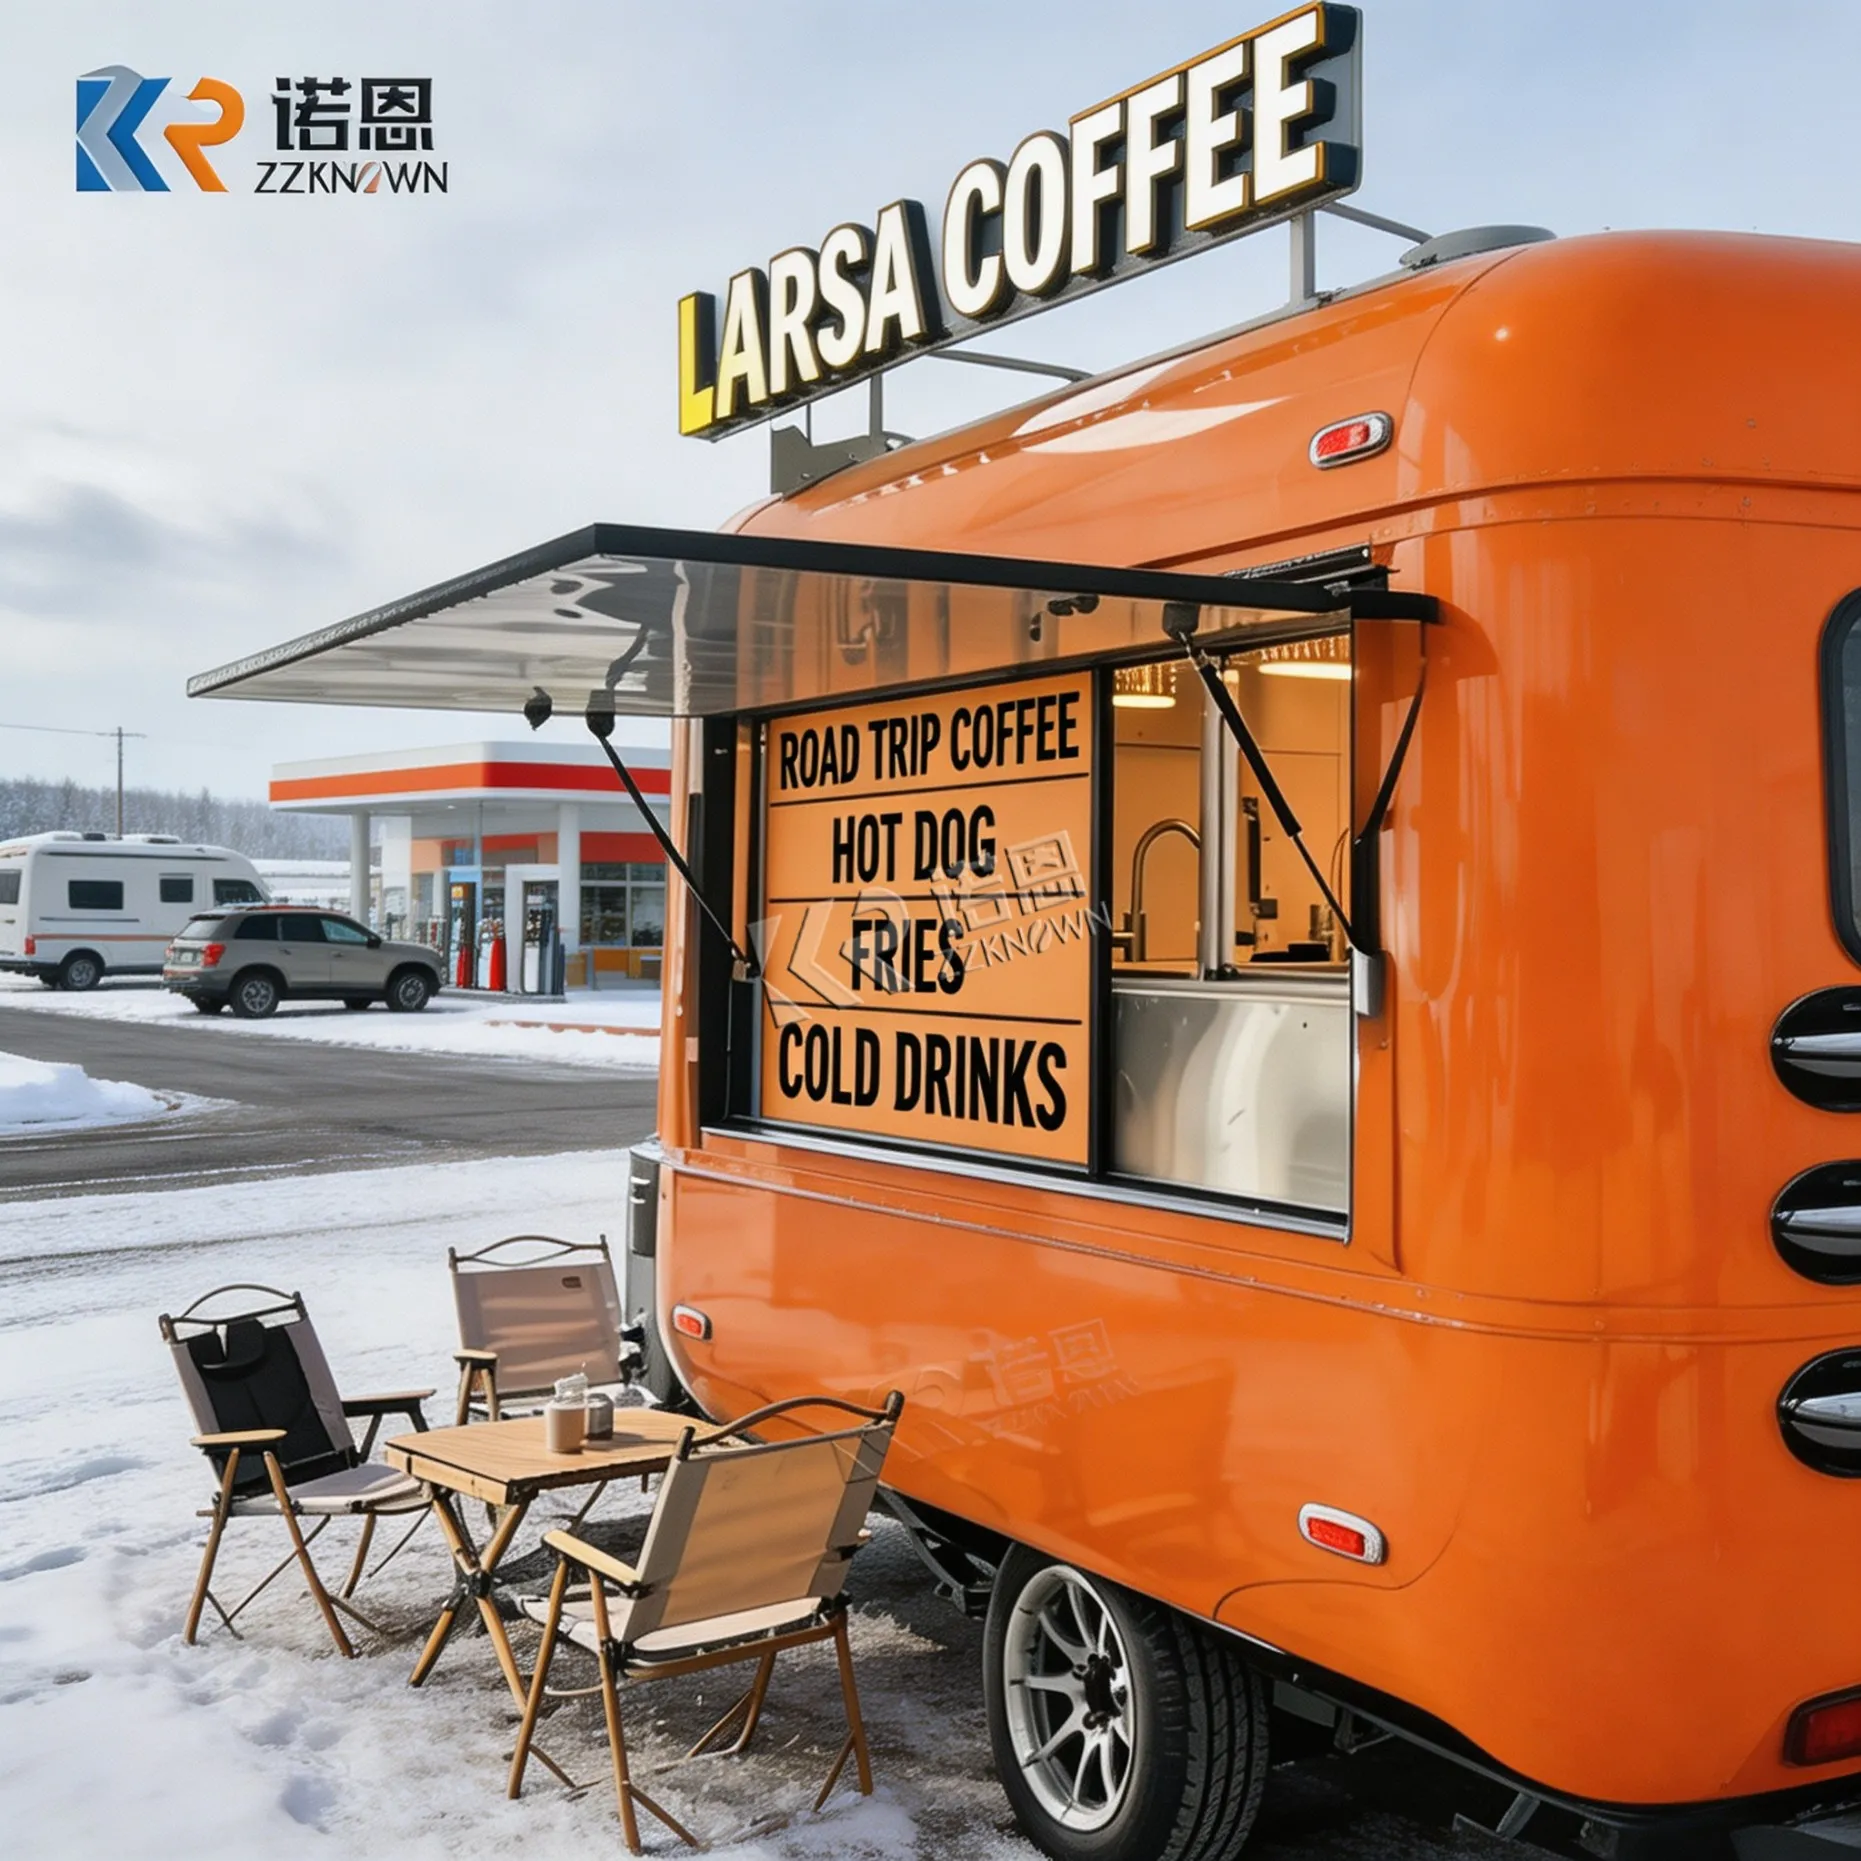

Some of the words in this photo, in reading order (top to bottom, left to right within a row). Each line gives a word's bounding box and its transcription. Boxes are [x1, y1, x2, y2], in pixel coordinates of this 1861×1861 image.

[678, 198, 930, 439] LARSA
[941, 1, 1336, 319] COFFEE
[780, 726, 860, 790] ROAD
[867, 712, 941, 781] TRIP
[949, 691, 1080, 771] COFFEE
[832, 812, 903, 884] HOT
[914, 804, 996, 881] DOG
[851, 918, 964, 995] FRIES
[778, 1021, 880, 1108] COLD
[895, 1030, 1067, 1132] DRINKS
